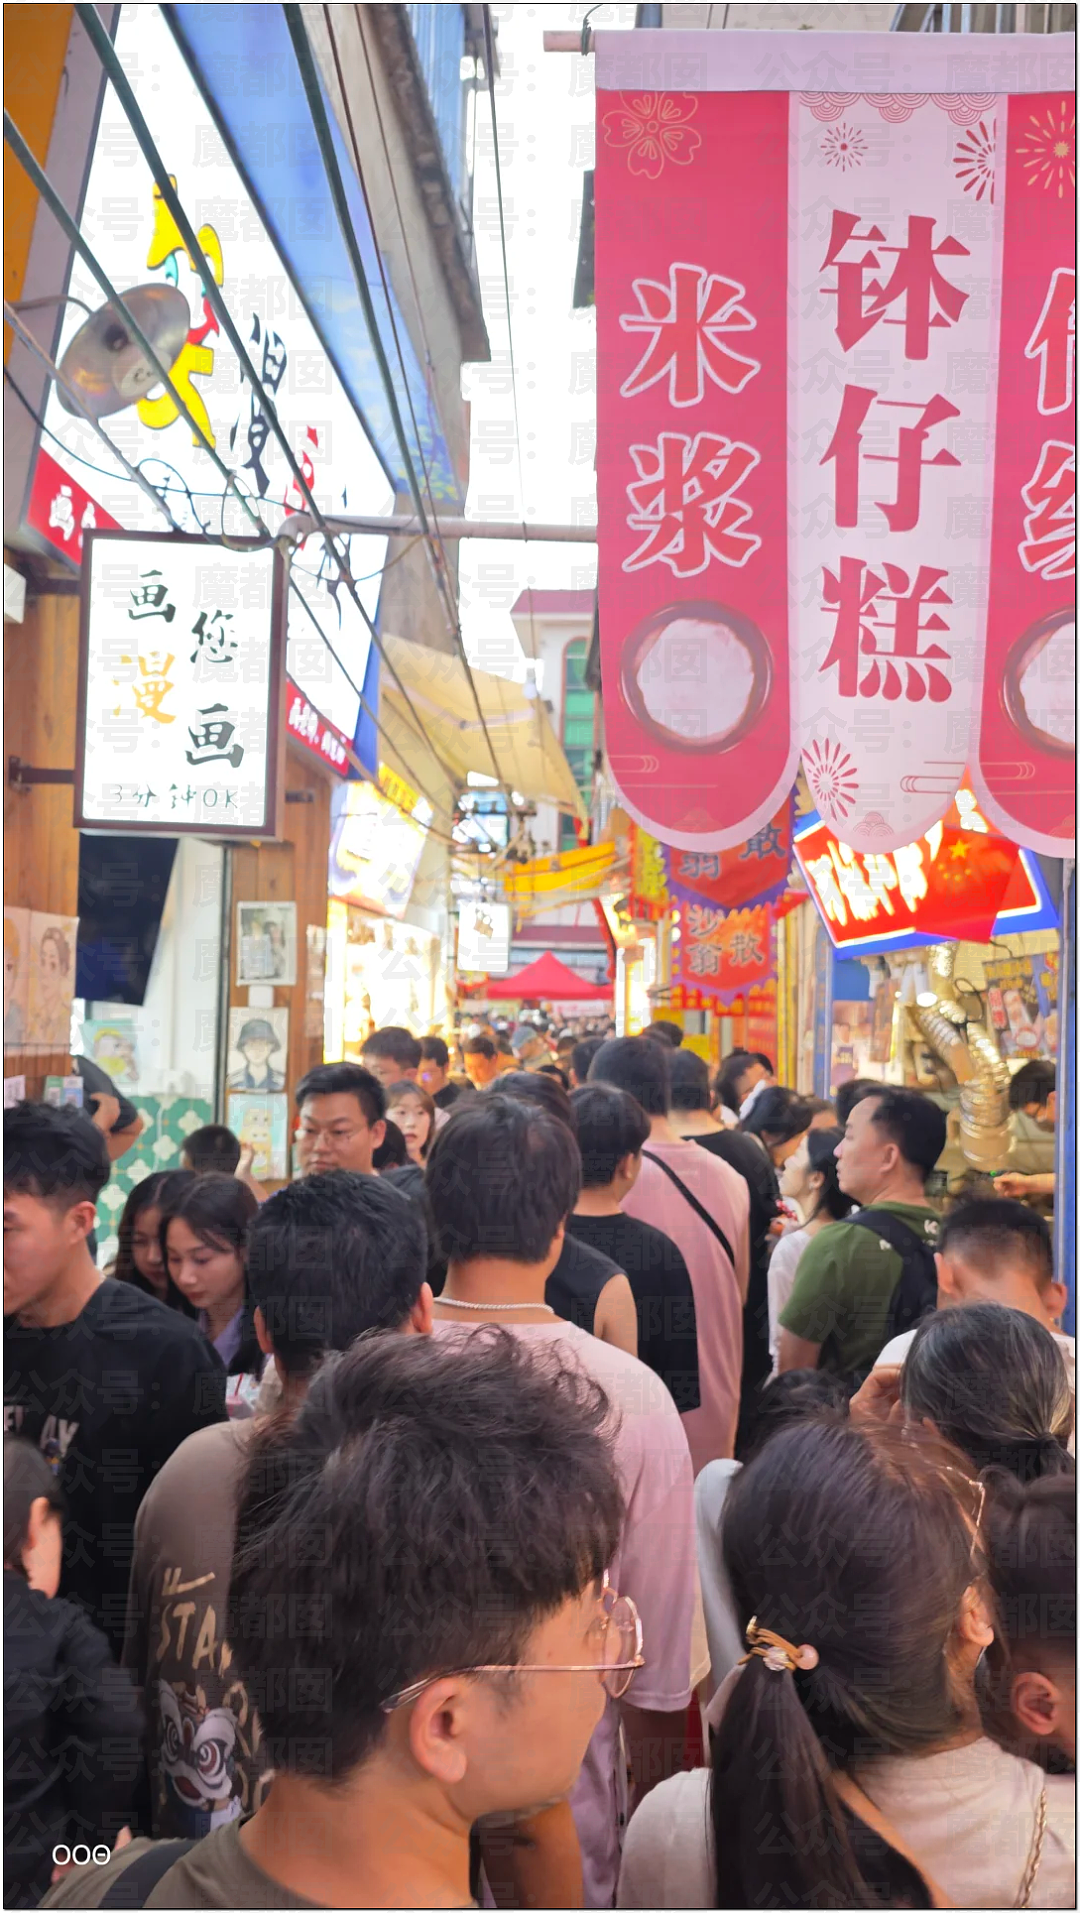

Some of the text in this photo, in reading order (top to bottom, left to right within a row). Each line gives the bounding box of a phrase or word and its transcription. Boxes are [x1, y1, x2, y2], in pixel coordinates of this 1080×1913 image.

[618, 262, 762, 578] 米浆
[819, 209, 971, 703] 钵仔糕
